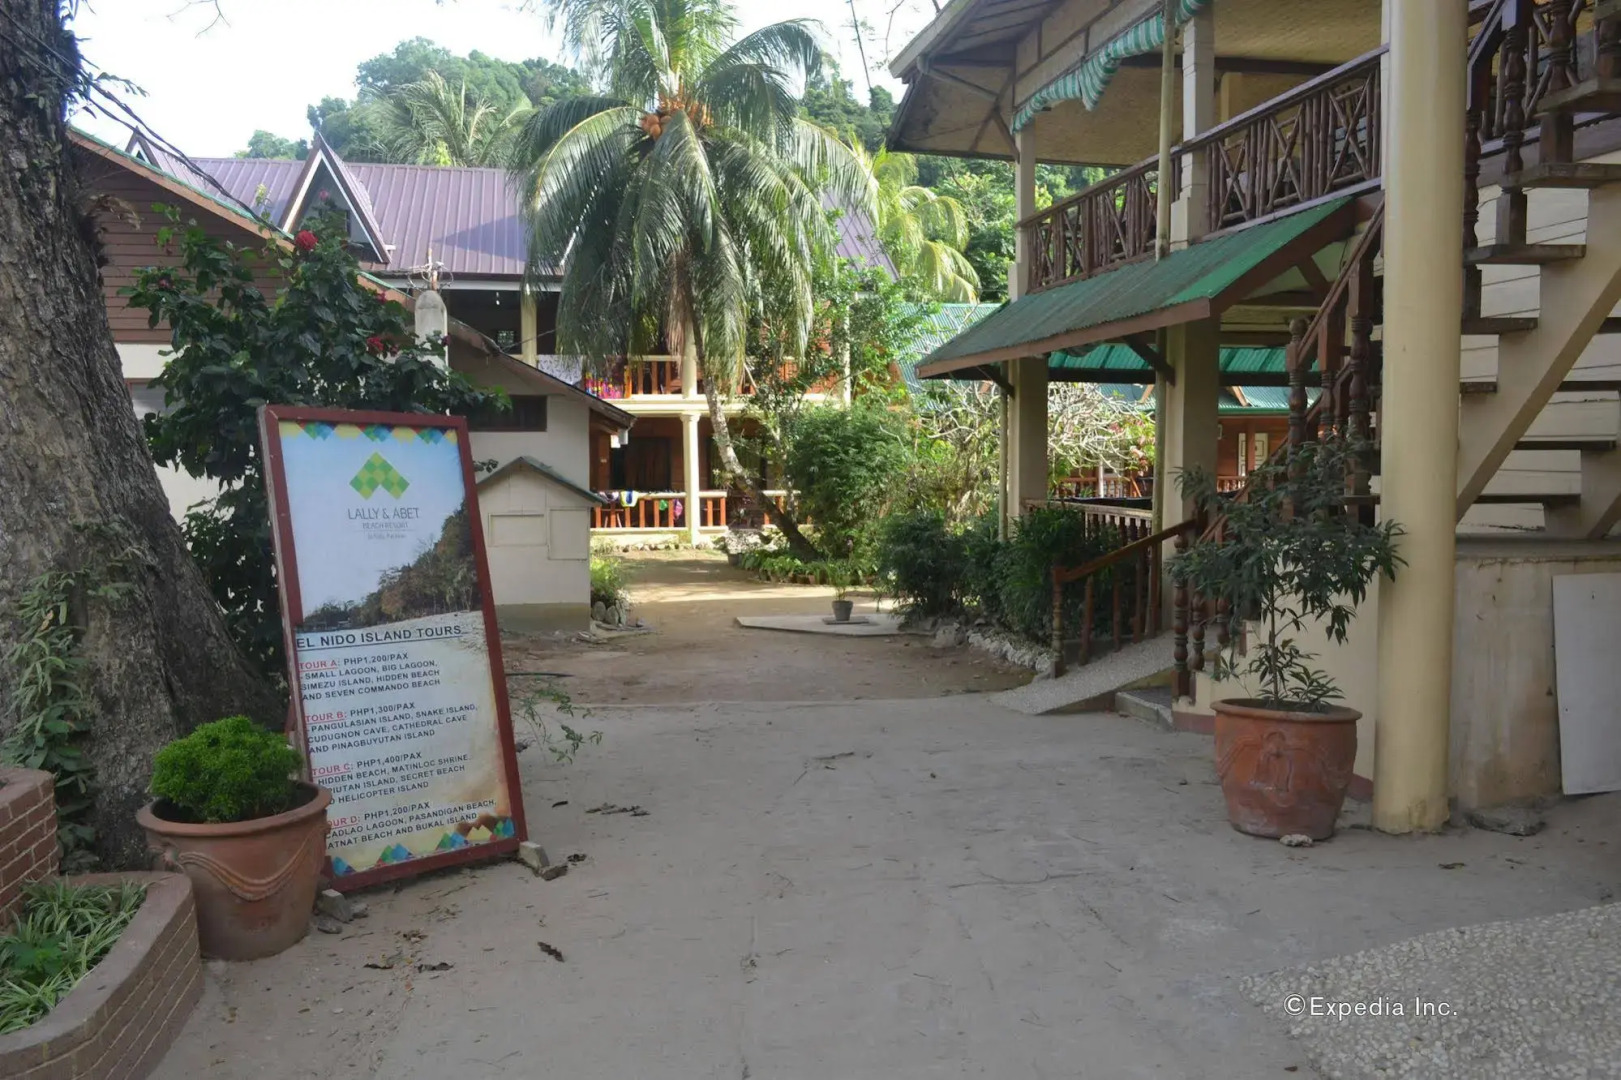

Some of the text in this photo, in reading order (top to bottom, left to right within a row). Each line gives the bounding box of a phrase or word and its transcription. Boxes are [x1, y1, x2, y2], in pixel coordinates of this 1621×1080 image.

[348, 507, 419, 520] LALLY & ABET
[296, 625, 462, 648] EL NIDO ISLAND TOURS
[300, 660, 327, 670] TOUR
[305, 671, 336, 680] SMALL
[340, 666, 379, 676] LAGOON,
[400, 660, 438, 670] LAGOON,
[302, 670, 440, 690] SIMEZU ISLAND, HIDDEN BEACH
[325, 689, 355, 698] SEVEN
[358, 683, 409, 694] COMMANDO
[412, 680, 440, 688] BEACH
[306, 713, 333, 722] TOUR
[350, 702, 415, 717] PHP1,300/PAX
[311, 718, 377, 732] PANGULASIAN
[380, 713, 413, 723] ISLAND,
[416, 709, 444, 718] SNAKE
[446, 704, 478, 713] ISLAND,
[308, 730, 360, 743] CUDUGNON
[392, 718, 443, 731] CATHEDRAL
[446, 714, 467, 723] CAVE
[309, 729, 435, 754] AND PINAGBUYUTAN ISLAND
[312, 765, 340, 776] TOUR
[357, 752, 422, 768] PHP1,400/PAX
[318, 774, 353, 785] HIDDEN
[356, 769, 390, 779] BEACH,
[392, 760, 436, 773] MATINLOC
[330, 765, 465, 793] IUTAN ISLAND, SECRET BEACH
[338, 787, 395, 803] HELICOPTER
[398, 782, 428, 792] ISLAND
[328, 817, 347, 827] OUR
[364, 802, 430, 820] PHP1,200/PAX
[366, 818, 407, 831] LAGOON,
[409, 806, 464, 822] PASANDIGAN
[328, 812, 477, 850] ATNAT BEACH AND BUKAL ISLAND
